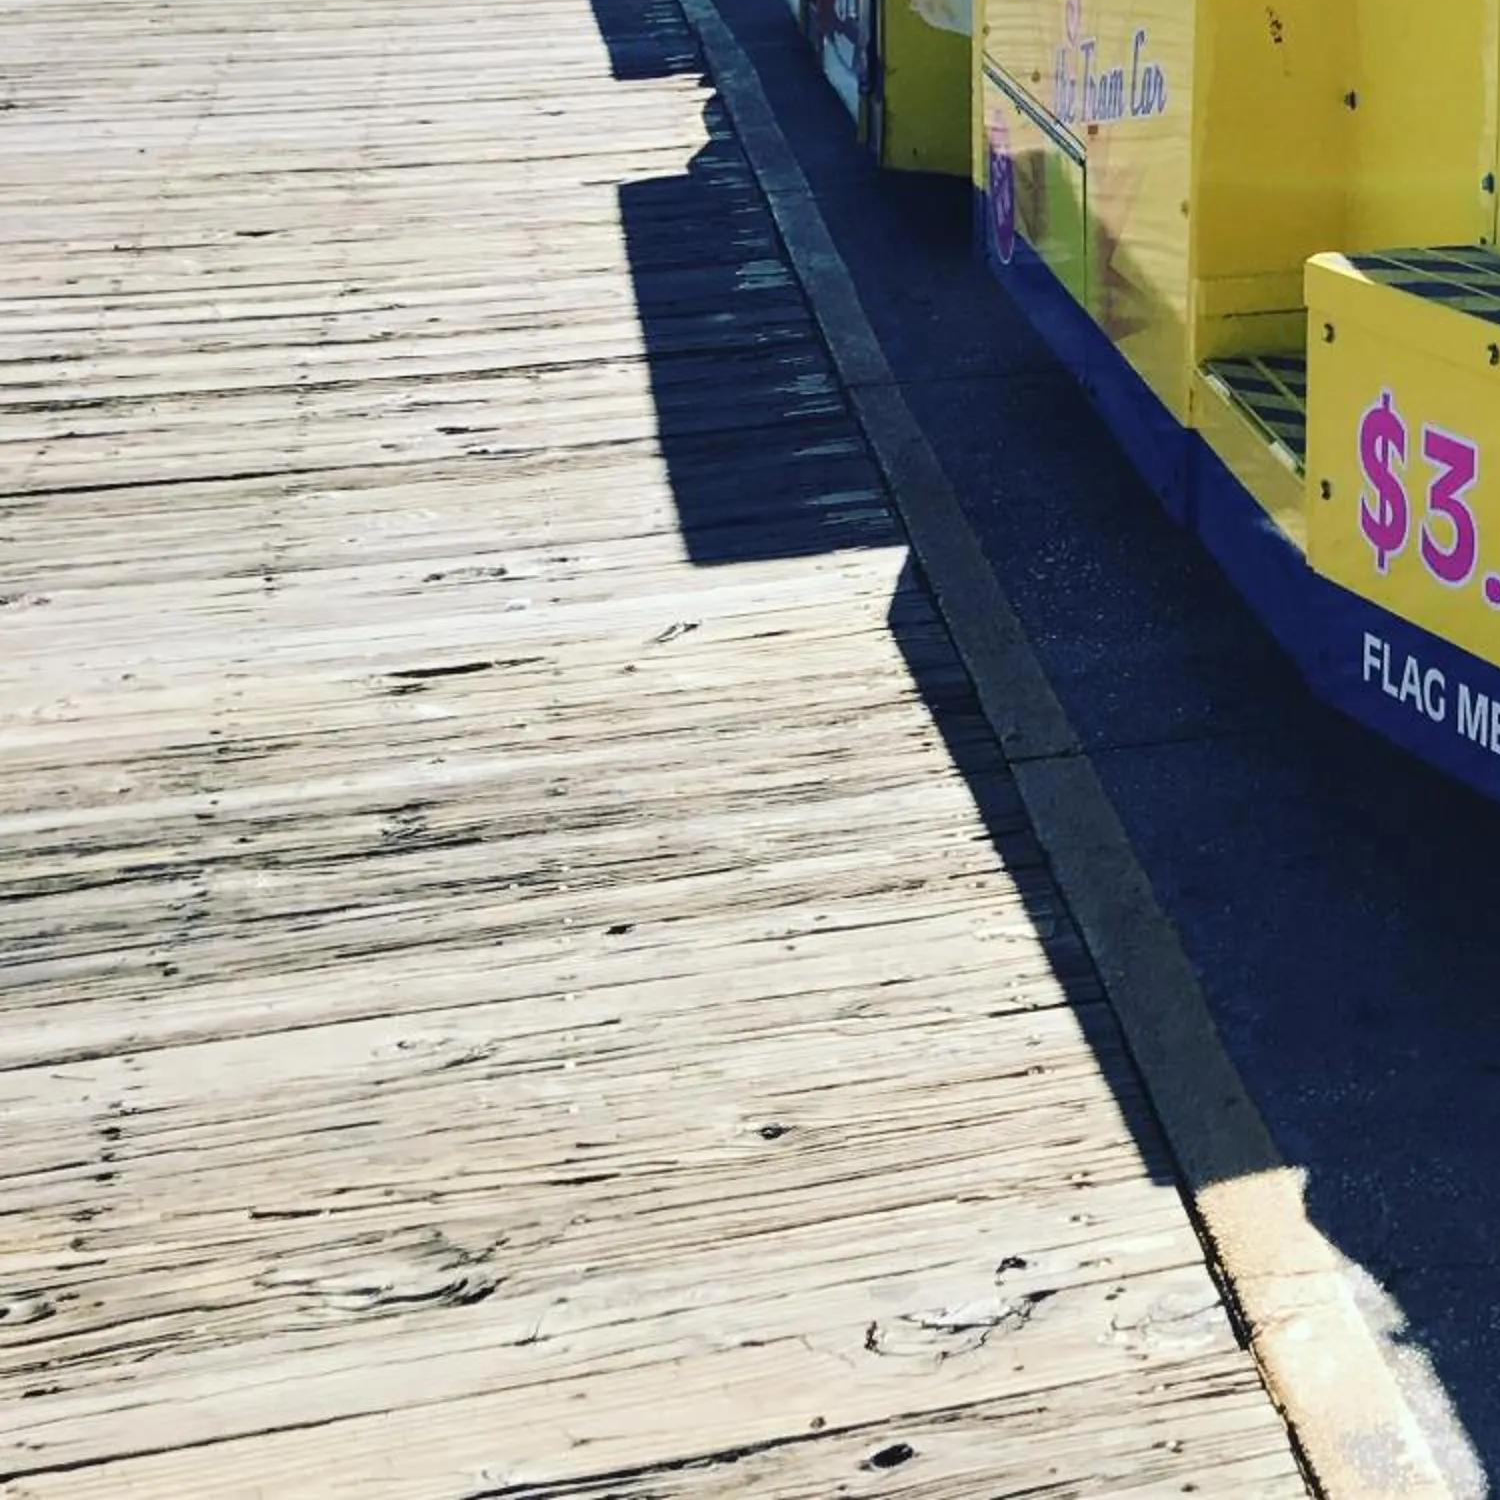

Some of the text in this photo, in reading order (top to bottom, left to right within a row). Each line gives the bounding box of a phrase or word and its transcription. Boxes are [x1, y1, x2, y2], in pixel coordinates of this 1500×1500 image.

[1080, 38, 1125, 124] Tram
[1131, 29, 1167, 117] Car
[1362, 631, 1446, 722] FLAG
